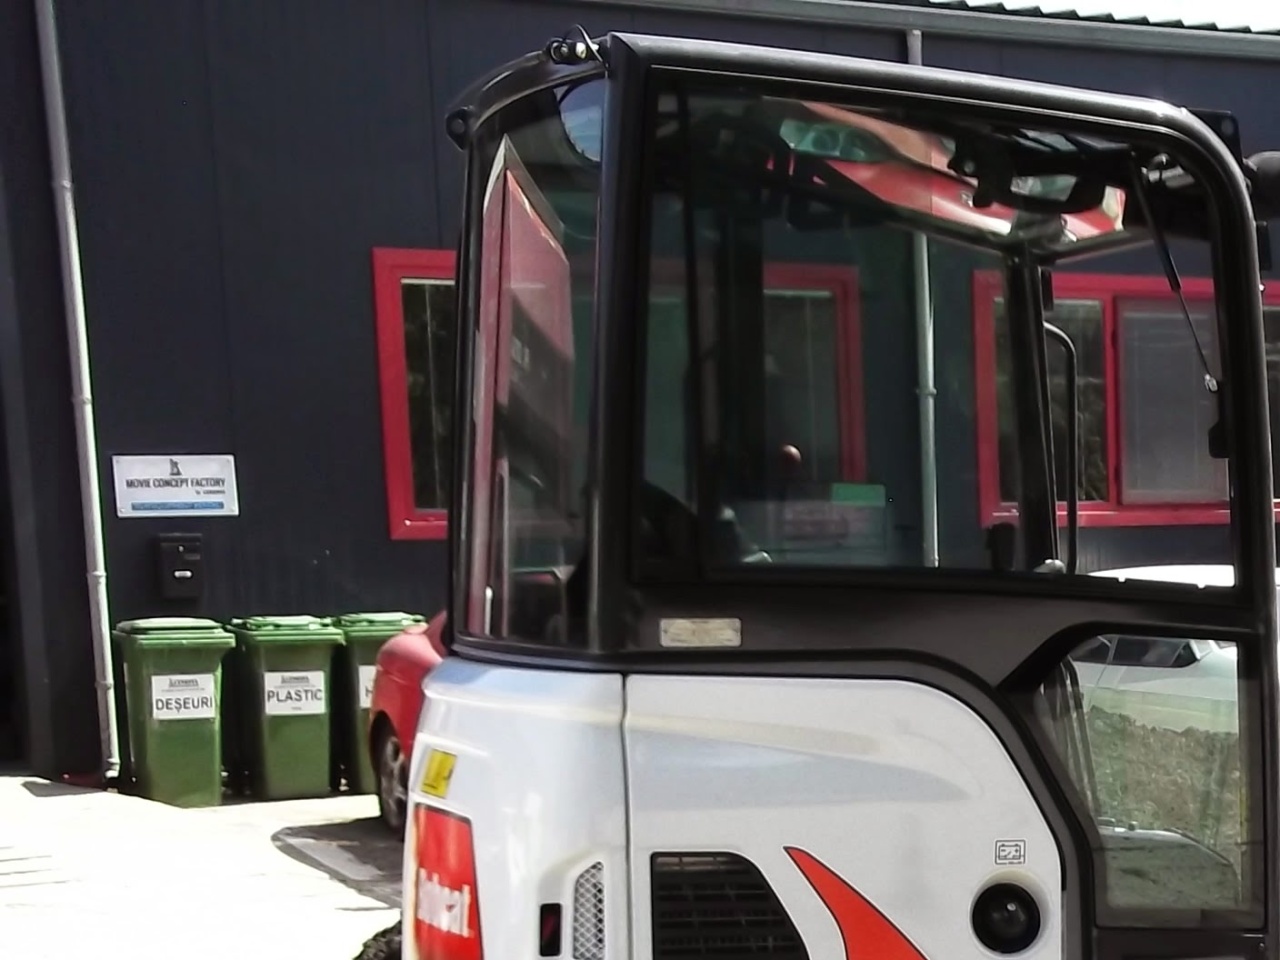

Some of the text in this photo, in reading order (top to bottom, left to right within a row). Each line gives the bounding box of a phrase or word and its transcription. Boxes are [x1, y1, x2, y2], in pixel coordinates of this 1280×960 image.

[126, 477, 226, 489] MOVIE CONCEPT FACTORY
[267, 688, 323, 703] PLASTIC
